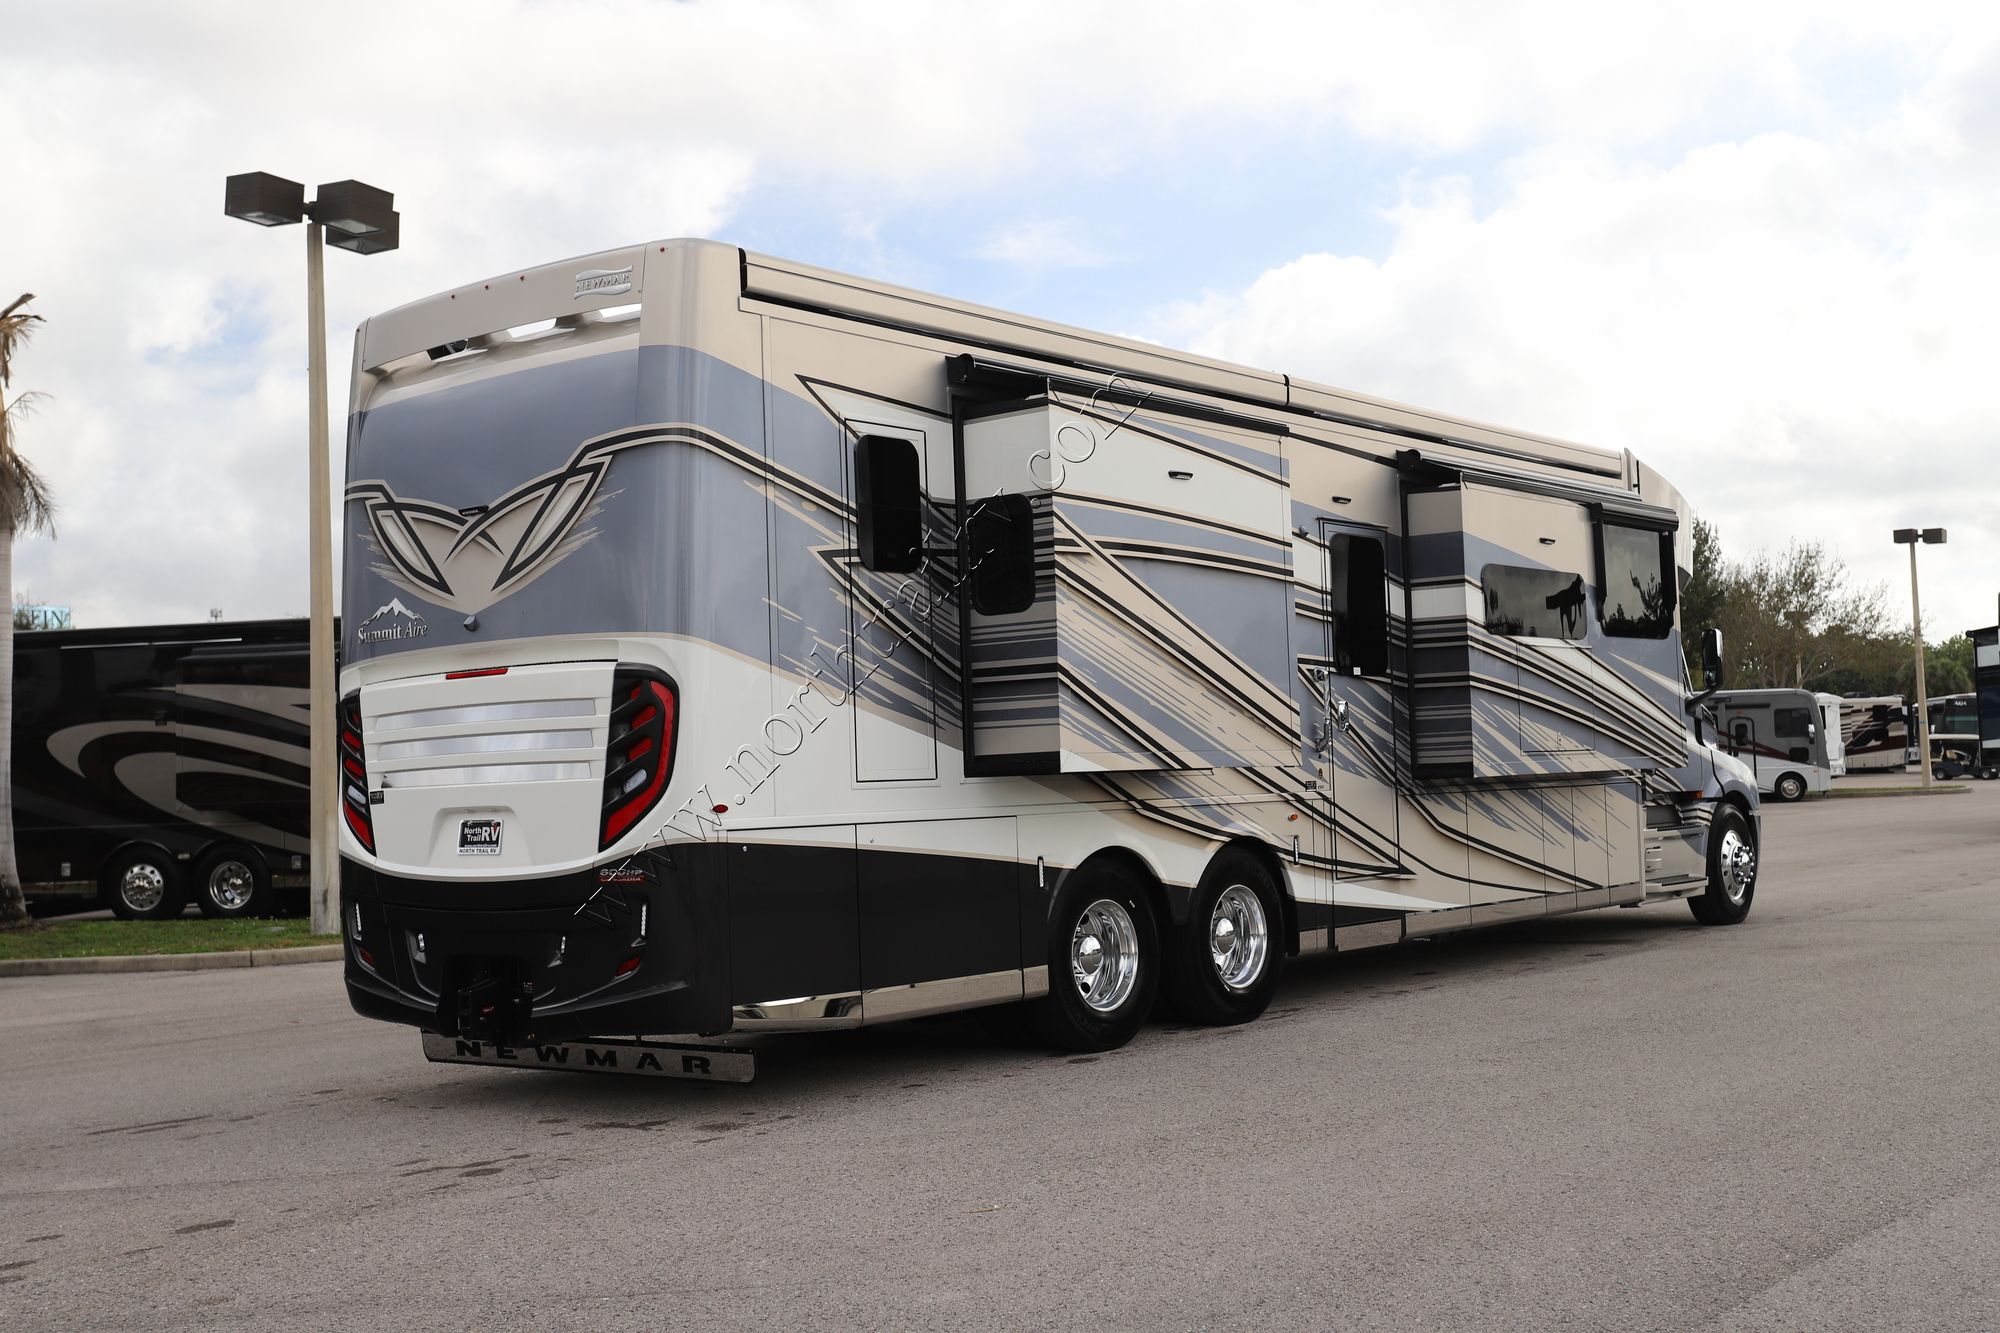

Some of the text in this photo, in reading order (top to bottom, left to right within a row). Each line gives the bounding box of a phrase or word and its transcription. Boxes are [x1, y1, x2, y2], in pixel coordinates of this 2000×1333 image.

[576, 273, 630, 292] NEWMAR
[358, 620, 428, 643] Summit Aire
[481, 826, 500, 841] RV
[456, 1040, 712, 1075] NEWMAR
